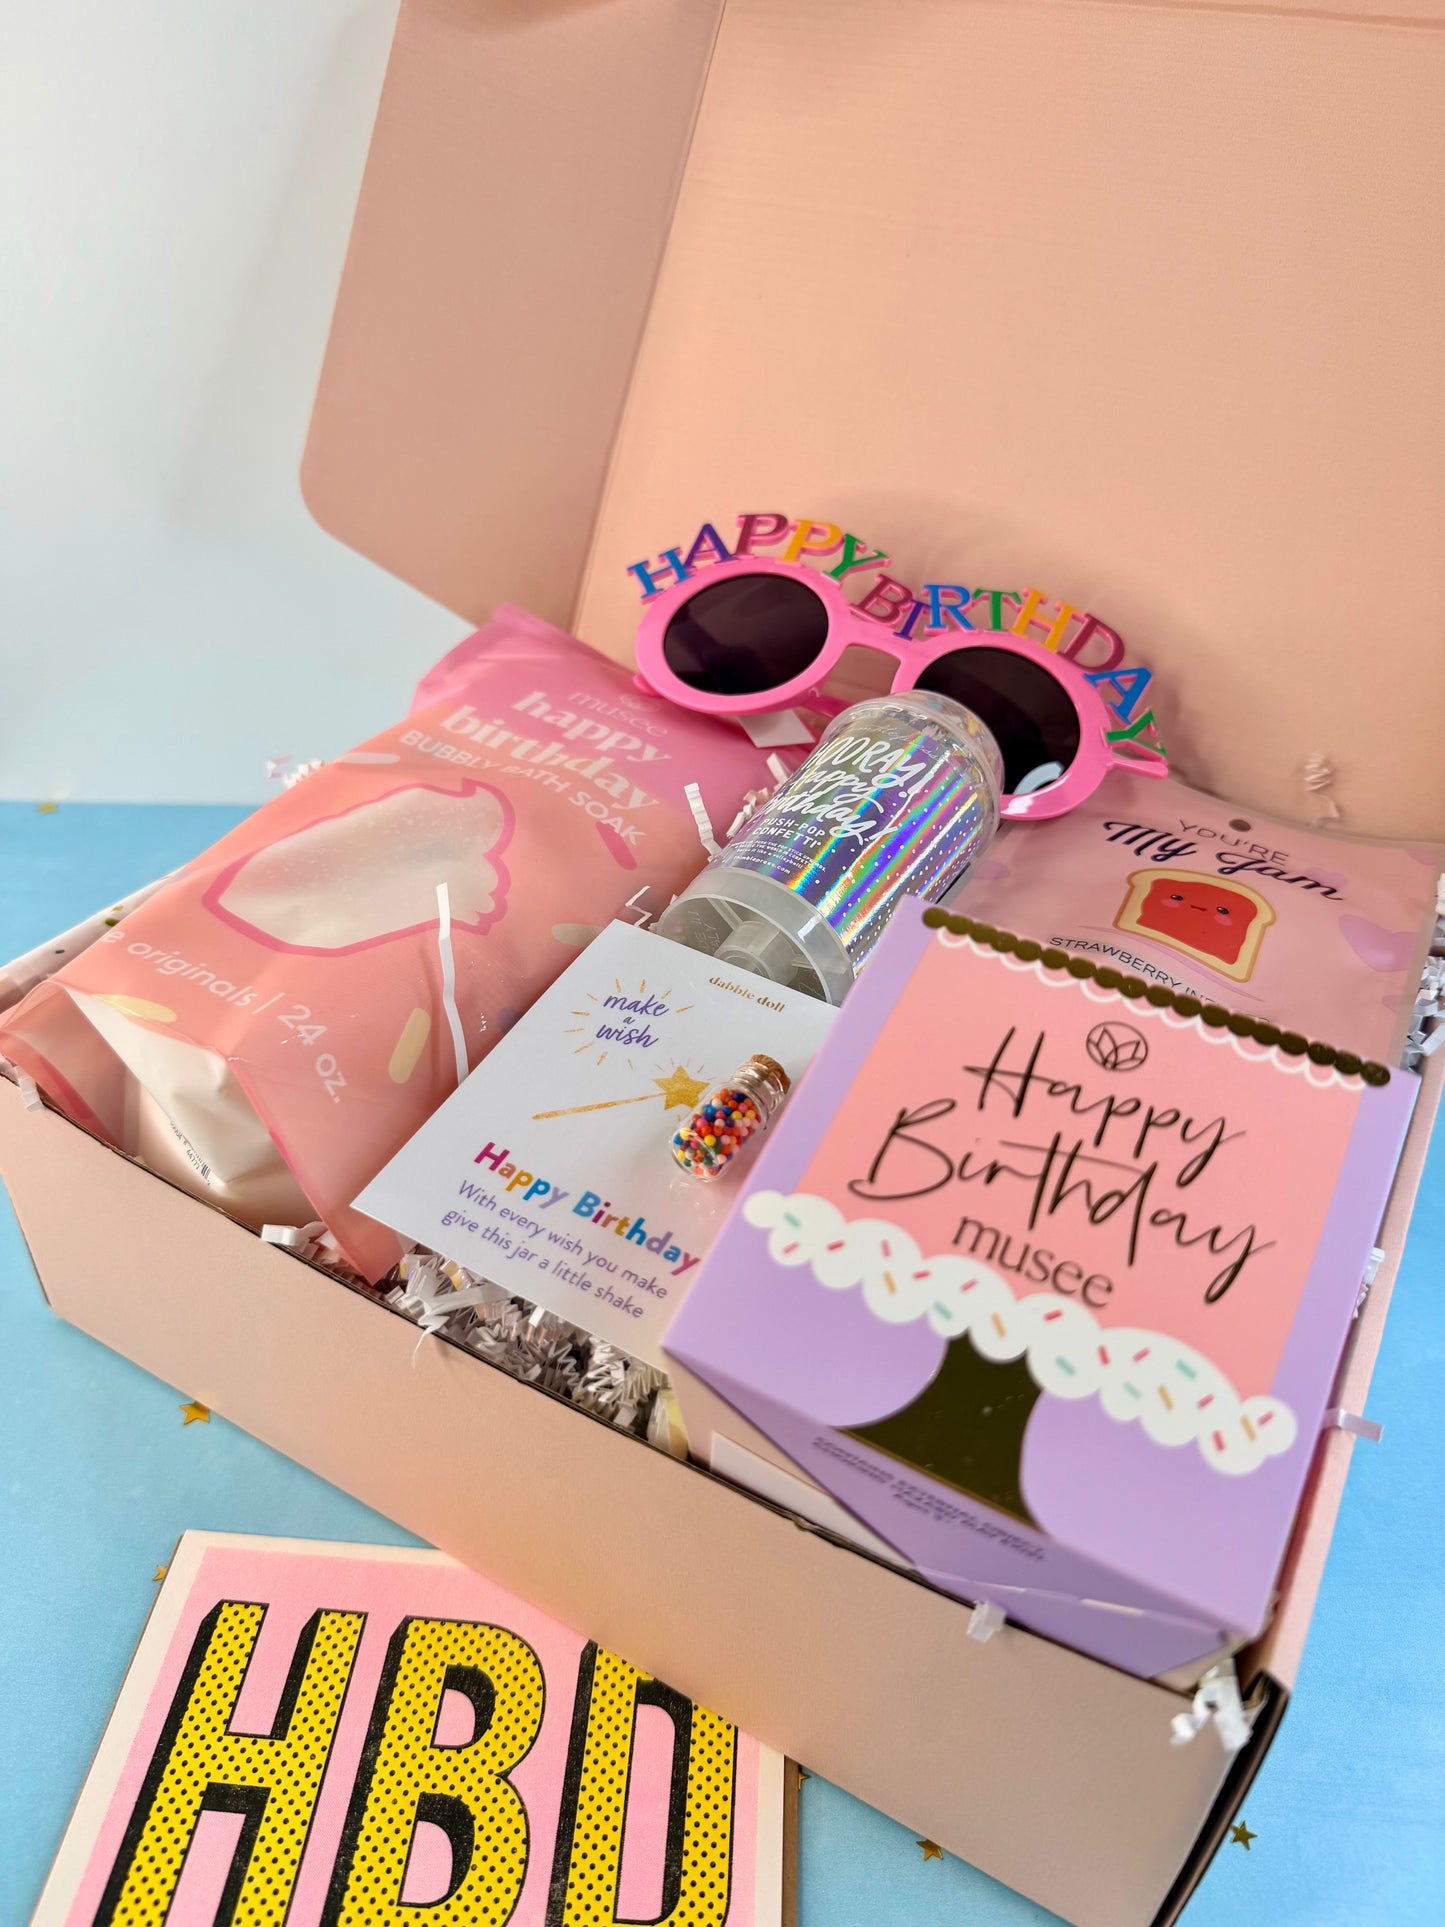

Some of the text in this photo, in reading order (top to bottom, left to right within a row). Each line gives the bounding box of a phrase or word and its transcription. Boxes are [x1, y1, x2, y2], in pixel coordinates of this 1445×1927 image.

[628, 513, 1168, 757] HAPPY BIRTHDAY
[440, 705, 660, 811] birthday
[512, 691, 672, 764] happy
[568, 692, 671, 737] musee
[400, 730, 650, 846] BUBBLY BATH SOAK
[760, 818, 826, 837] PUSH-POP
[1103, 820, 1343, 901] My Jam
[1179, 819, 1290, 866] YOU'RE
[602, 992, 671, 1019] make
[708, 976, 786, 1013] dabble doll
[1049, 936, 1182, 989] STRAWBERRY
[127, 940, 260, 1008] originals
[277, 1003, 327, 1046] 24
[315, 1052, 347, 1104] oz.
[596, 1022, 659, 1049] wish
[622, 1014, 635, 1025] a
[962, 1026, 1246, 1187] Happy
[457, 1179, 668, 1300] With every wish you make
[473, 1141, 702, 1276] Happy Birthday
[847, 1098, 1277, 1305] Birthday
[441, 1208, 645, 1319] give this jar a little shake
[951, 1215, 1114, 1309] musee
[90, 1599, 739, 1927] HBD
